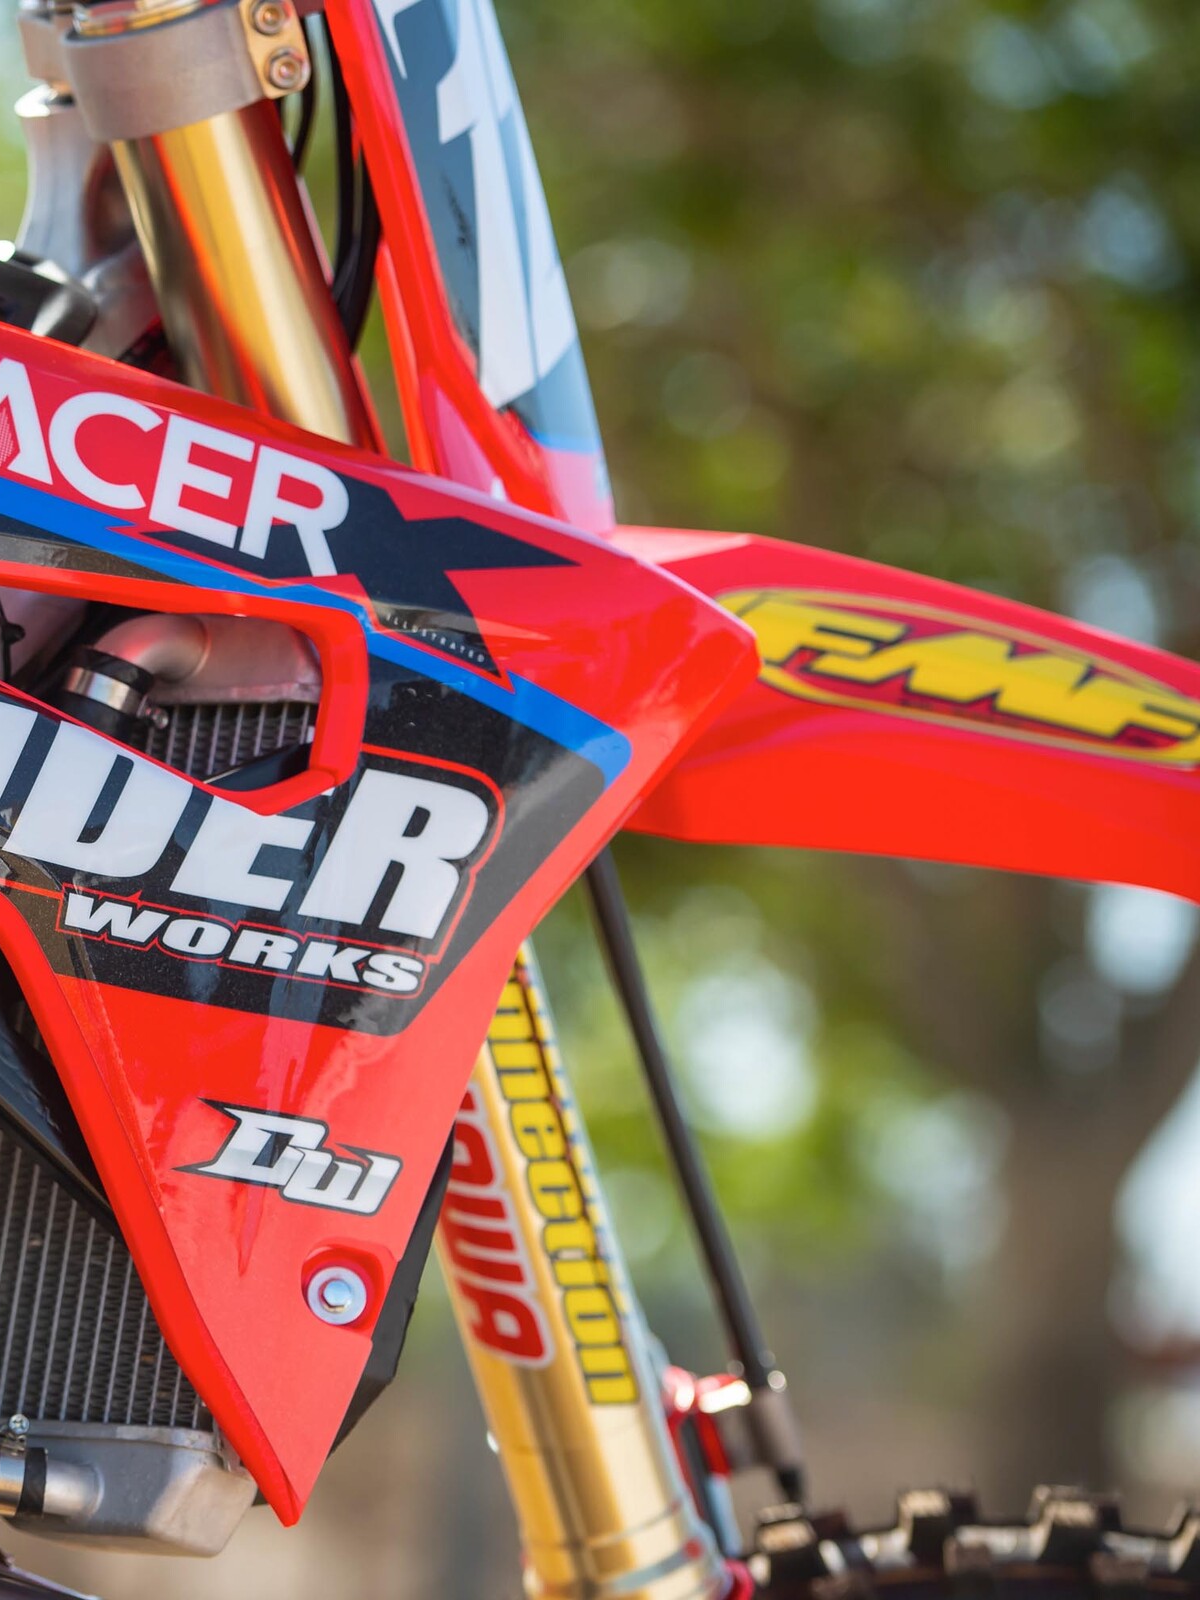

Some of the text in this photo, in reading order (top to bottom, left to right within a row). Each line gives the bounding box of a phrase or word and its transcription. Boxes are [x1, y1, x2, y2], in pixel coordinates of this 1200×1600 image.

[385, 612, 486, 664] ILLUSTRATED
[736, 593, 1200, 740] FMF
[62, 892, 425, 992] WORKS
[440, 1092, 546, 1361] OWA
[486, 945, 638, 1405] nnection
